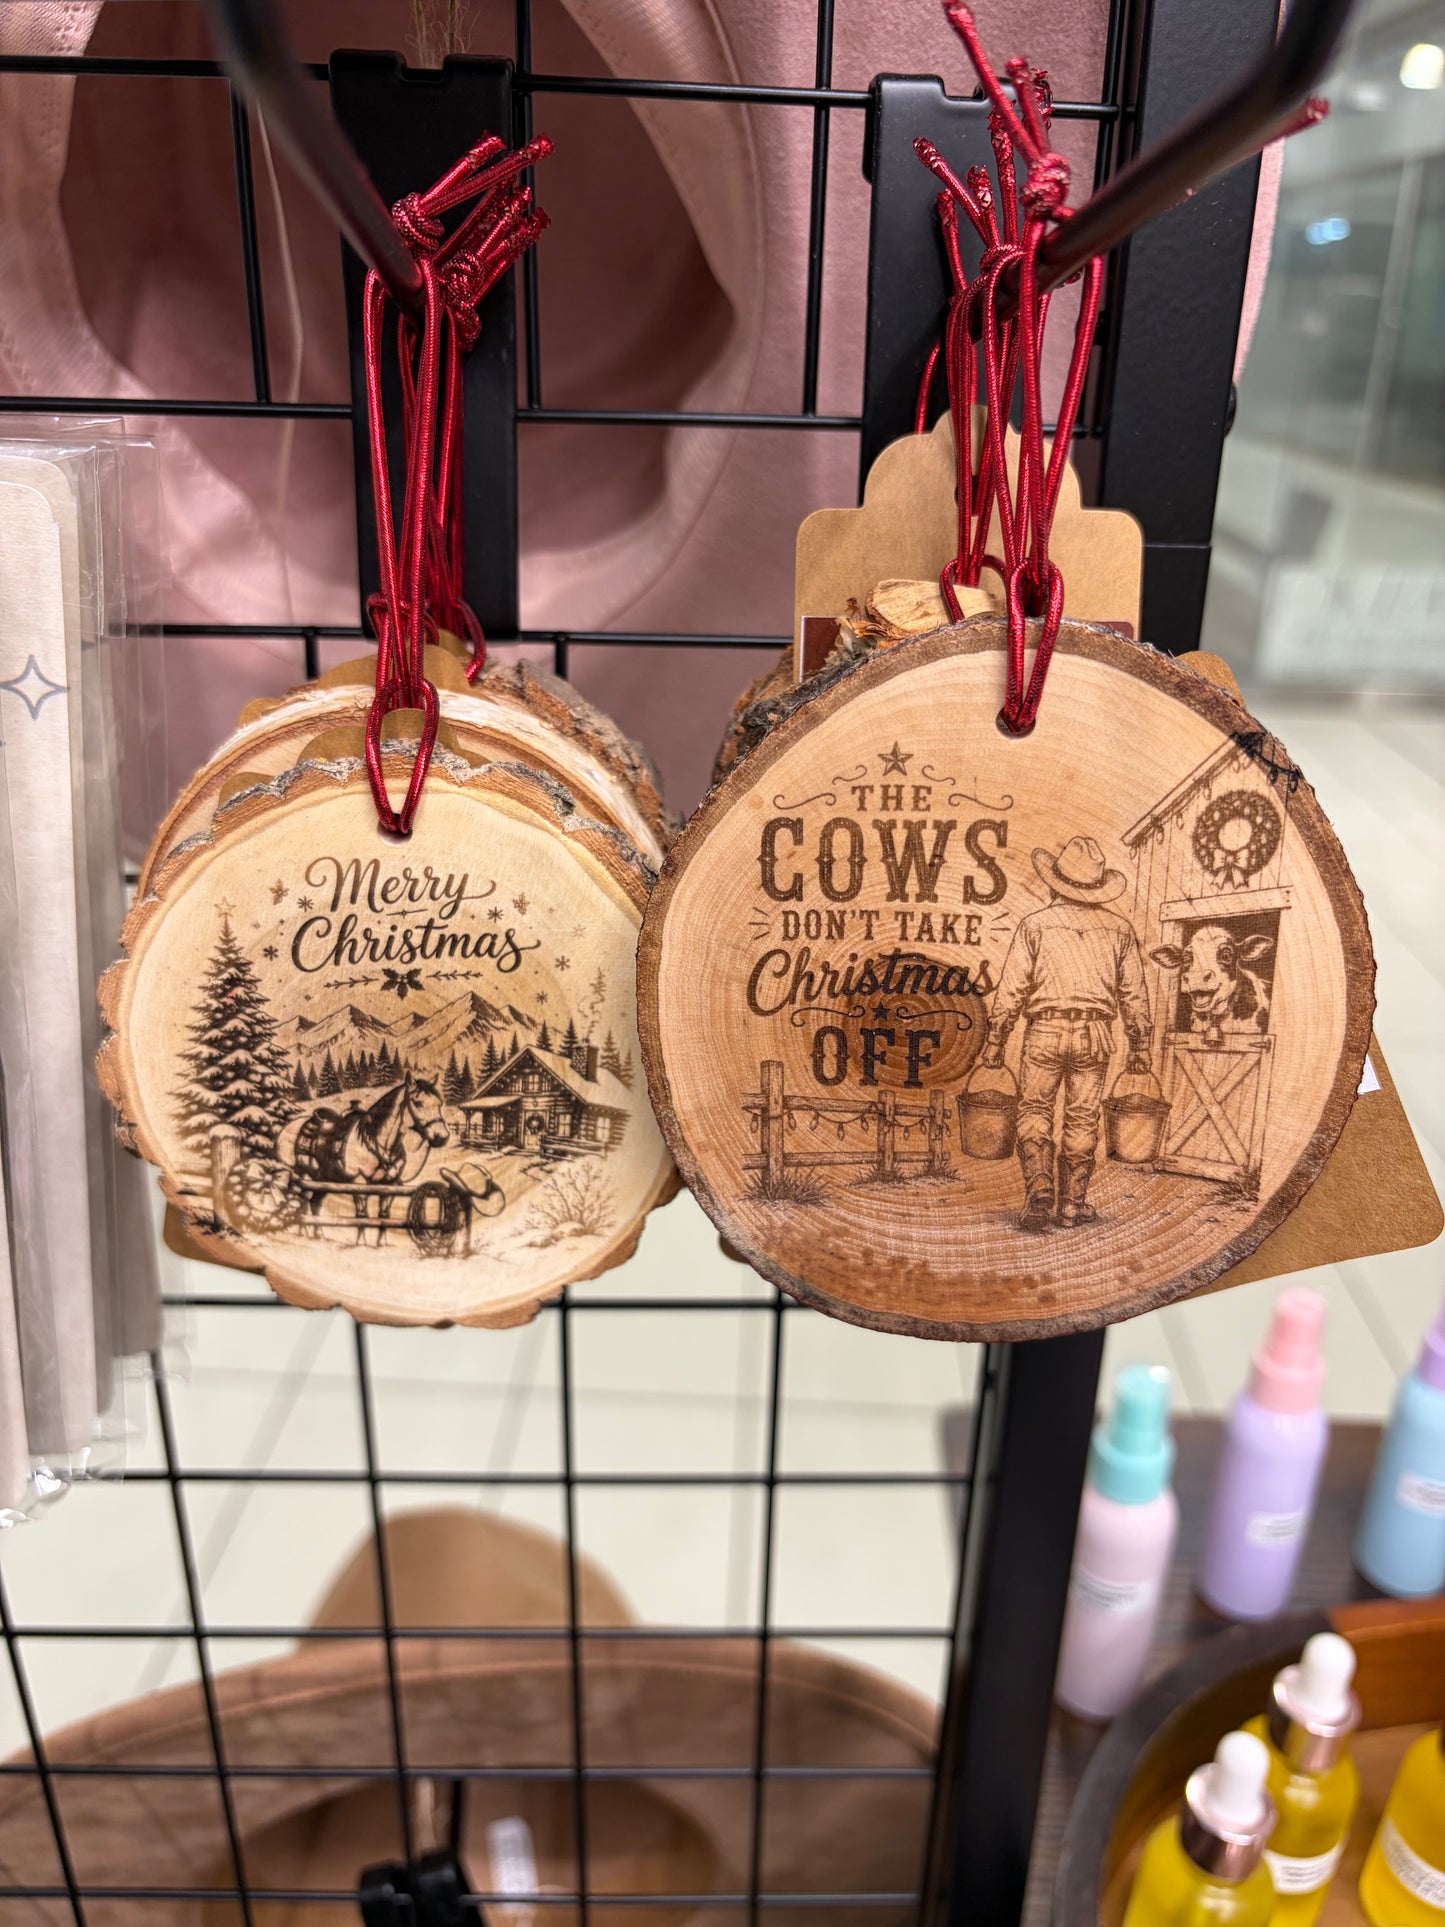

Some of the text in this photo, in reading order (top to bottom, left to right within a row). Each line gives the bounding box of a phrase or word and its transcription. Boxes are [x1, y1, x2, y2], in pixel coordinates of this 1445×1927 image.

[851, 784, 932, 811] THE
[305, 857, 496, 919] Merry
[757, 817, 1009, 906] COWS
[292, 914, 541, 973] Christmas
[782, 910, 982, 946] DON'T TAKE
[747, 947, 999, 1016] Christmas
[811, 1025, 941, 1089] OFF
